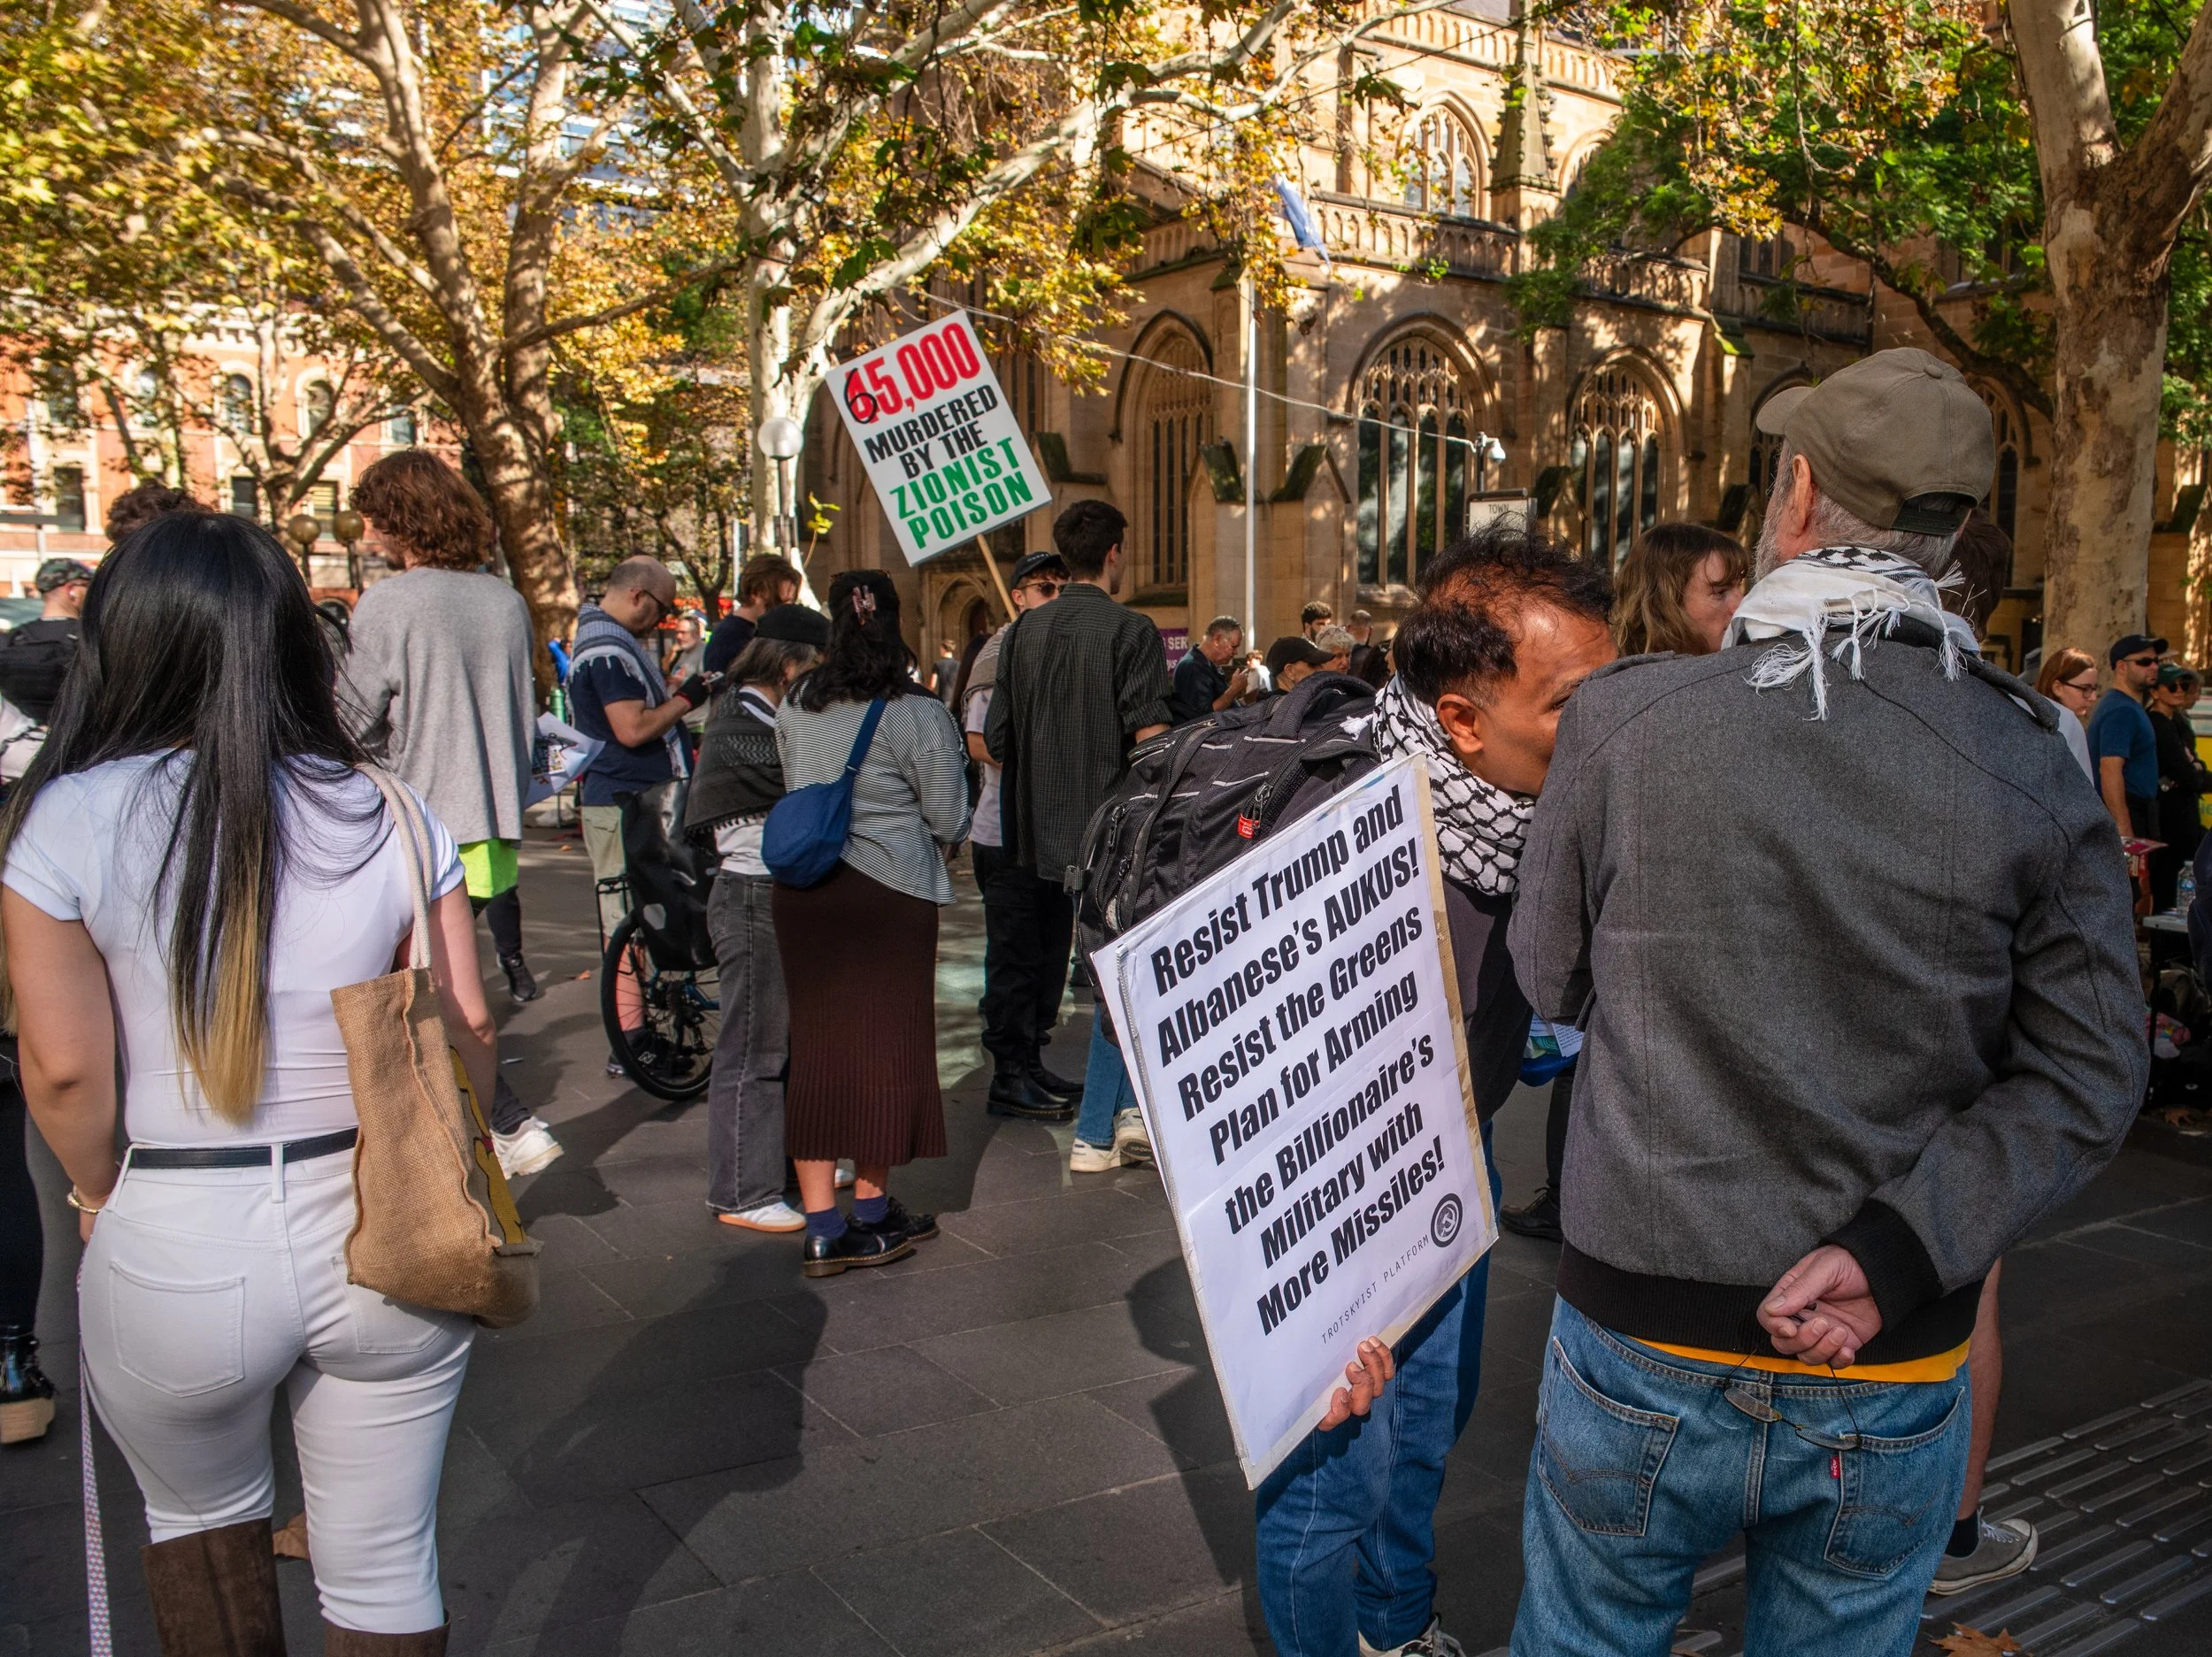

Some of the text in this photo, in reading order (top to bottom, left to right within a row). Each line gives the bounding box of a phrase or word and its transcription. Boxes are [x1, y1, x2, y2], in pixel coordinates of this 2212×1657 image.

[864, 384, 998, 464] MURDERED
[889, 436, 1019, 520] ZIONIST
[899, 420, 988, 479] BY THE
[907, 471, 1033, 549] POISON
[1488, 503, 1509, 514] TOWN
[1150, 785, 1404, 997] Resist Trump and
[1157, 838, 1420, 1069] Albanese's AUKUS!
[1177, 907, 1423, 1122] Resist the Greens
[1209, 971, 1418, 1167] Plan for Arming
[1225, 1035, 1434, 1235] the Billionaire's
[1260, 1103, 1424, 1270] Military with
[1256, 1135, 1445, 1336] More Missiles!
[1322, 1234, 1430, 1344] TROTSKYIST PLATFORM
